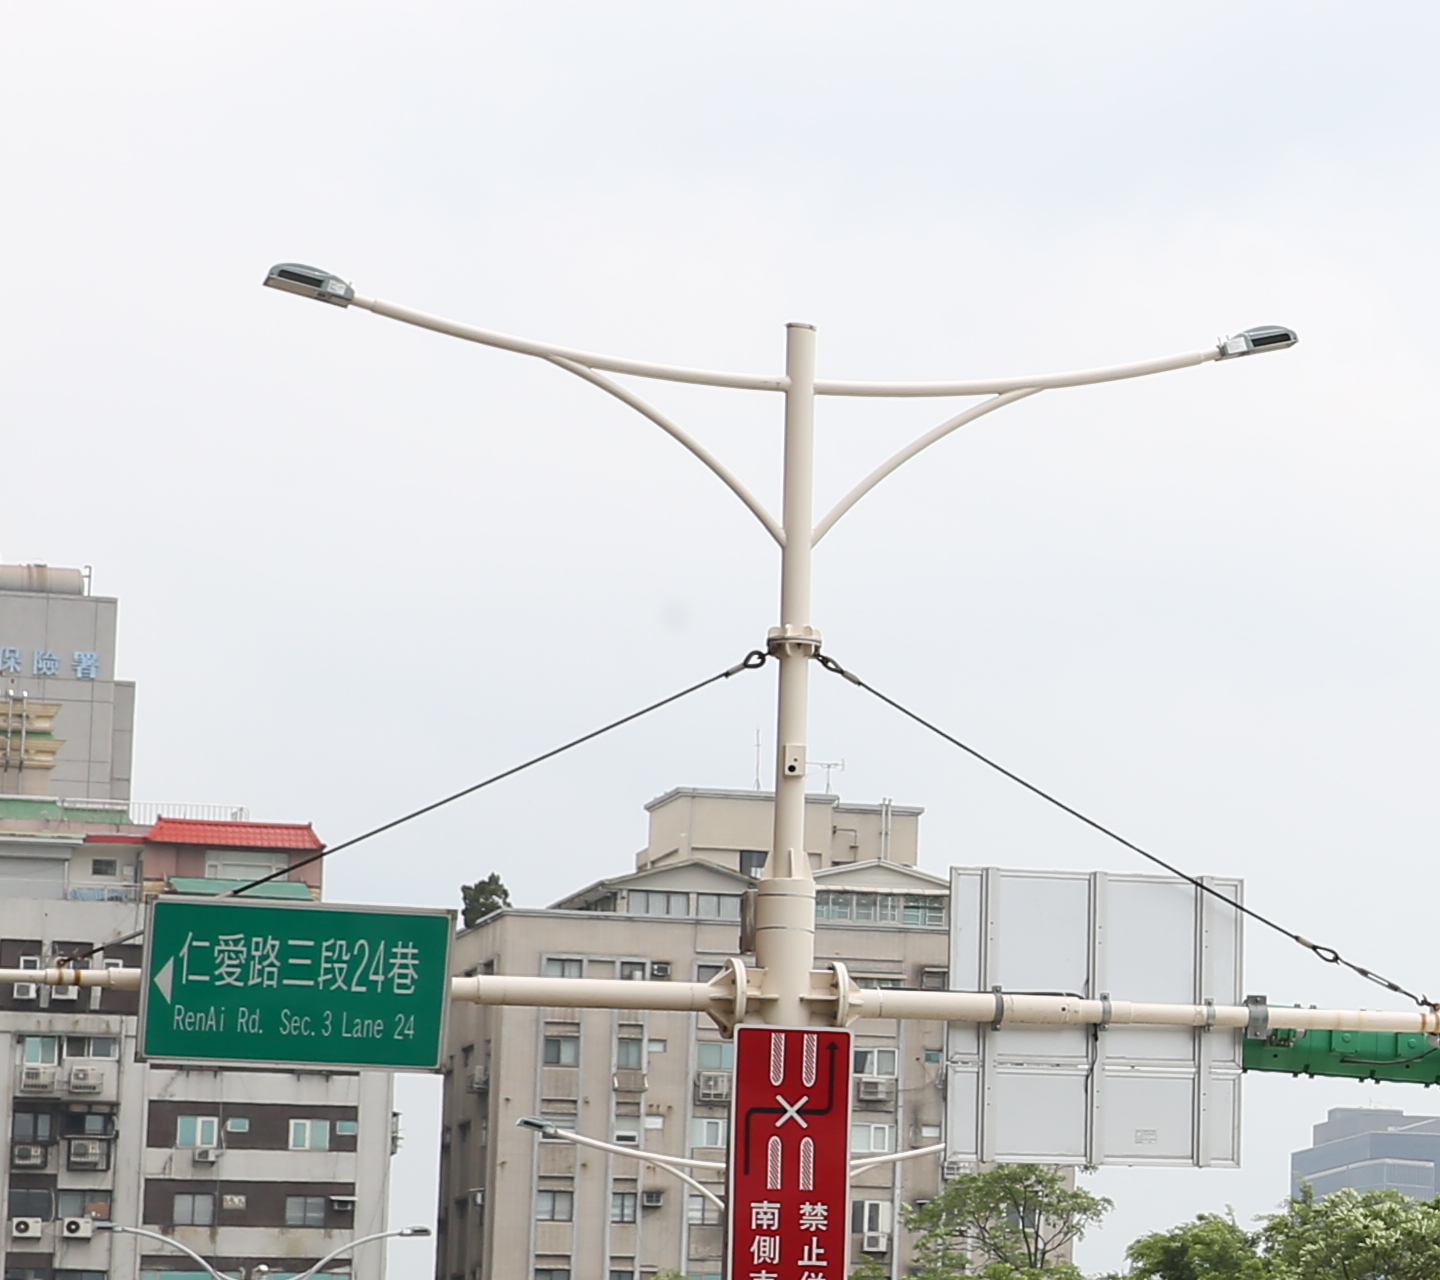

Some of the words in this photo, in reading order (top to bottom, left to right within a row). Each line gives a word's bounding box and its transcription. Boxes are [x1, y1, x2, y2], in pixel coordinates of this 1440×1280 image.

[0, 646, 99, 679] 保險署
[179, 931, 419, 995] 仁愛路三段24巷
[173, 1004, 225, 1032] RenAi
[237, 1007, 263, 1034] Rd.
[279, 1009, 315, 1037] Sec.
[322, 1011, 333, 1037] 3
[342, 1011, 384, 1039] Lane
[394, 1014, 415, 1040] 24
